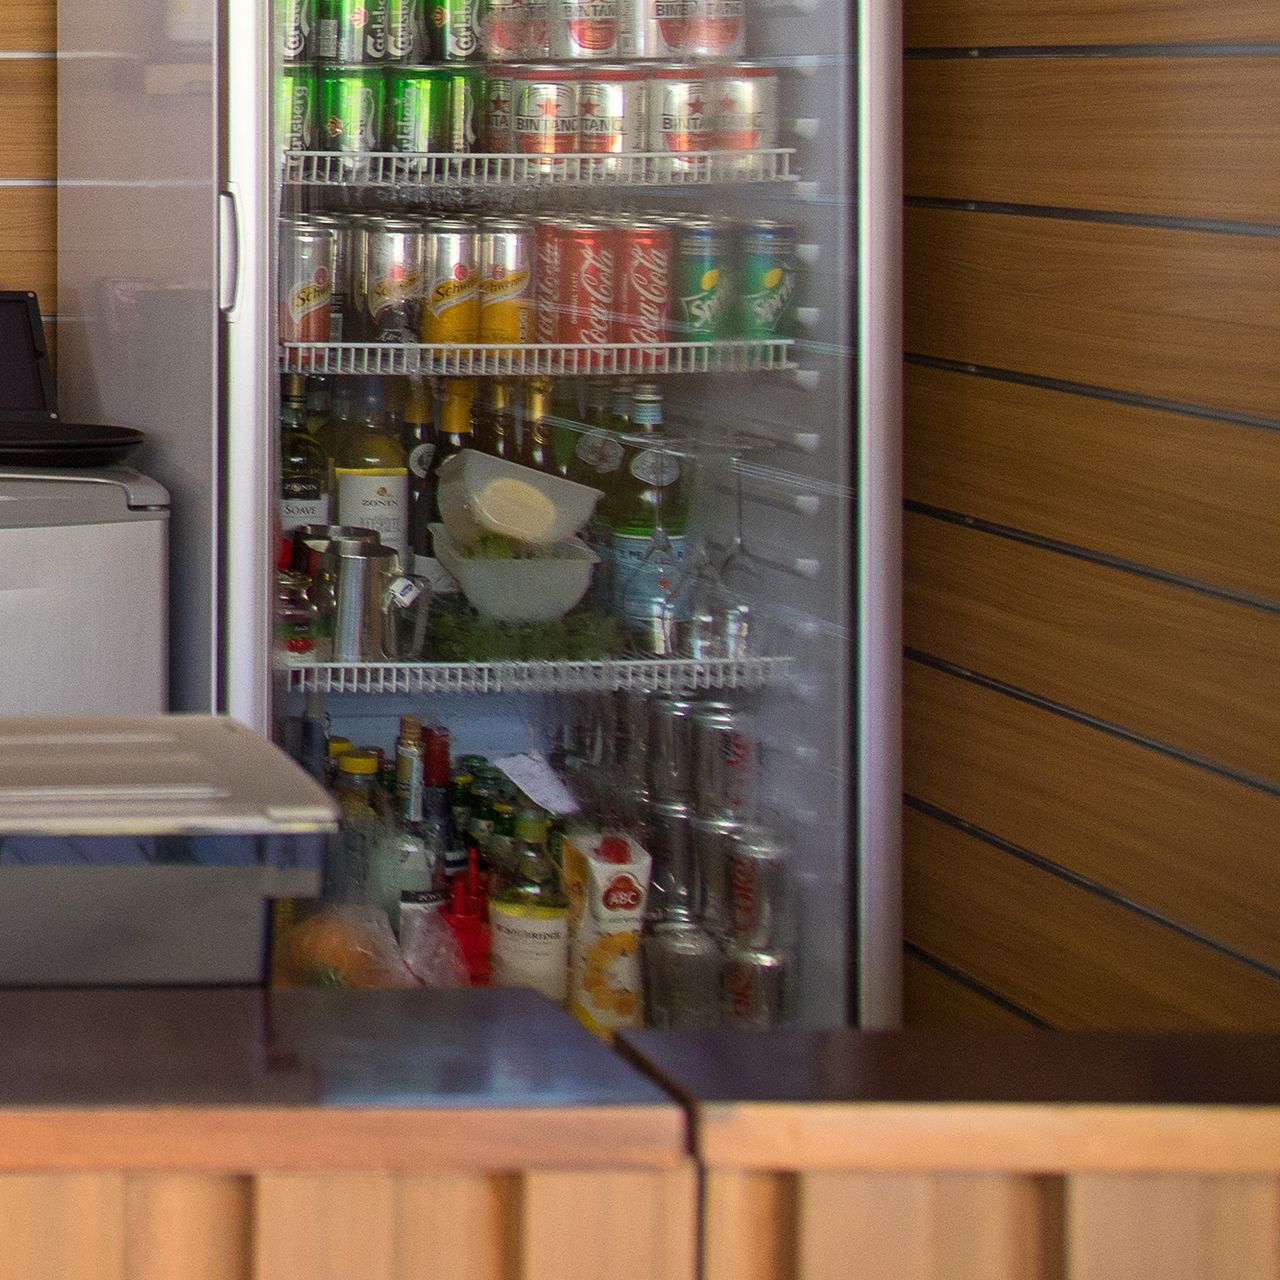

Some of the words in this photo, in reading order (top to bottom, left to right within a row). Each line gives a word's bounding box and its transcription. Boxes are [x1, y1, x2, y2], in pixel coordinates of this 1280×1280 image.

[284, 483, 317, 492] ZONIN
[285, 505, 317, 515] SOAVE
[607, 891, 638, 907] ABC
